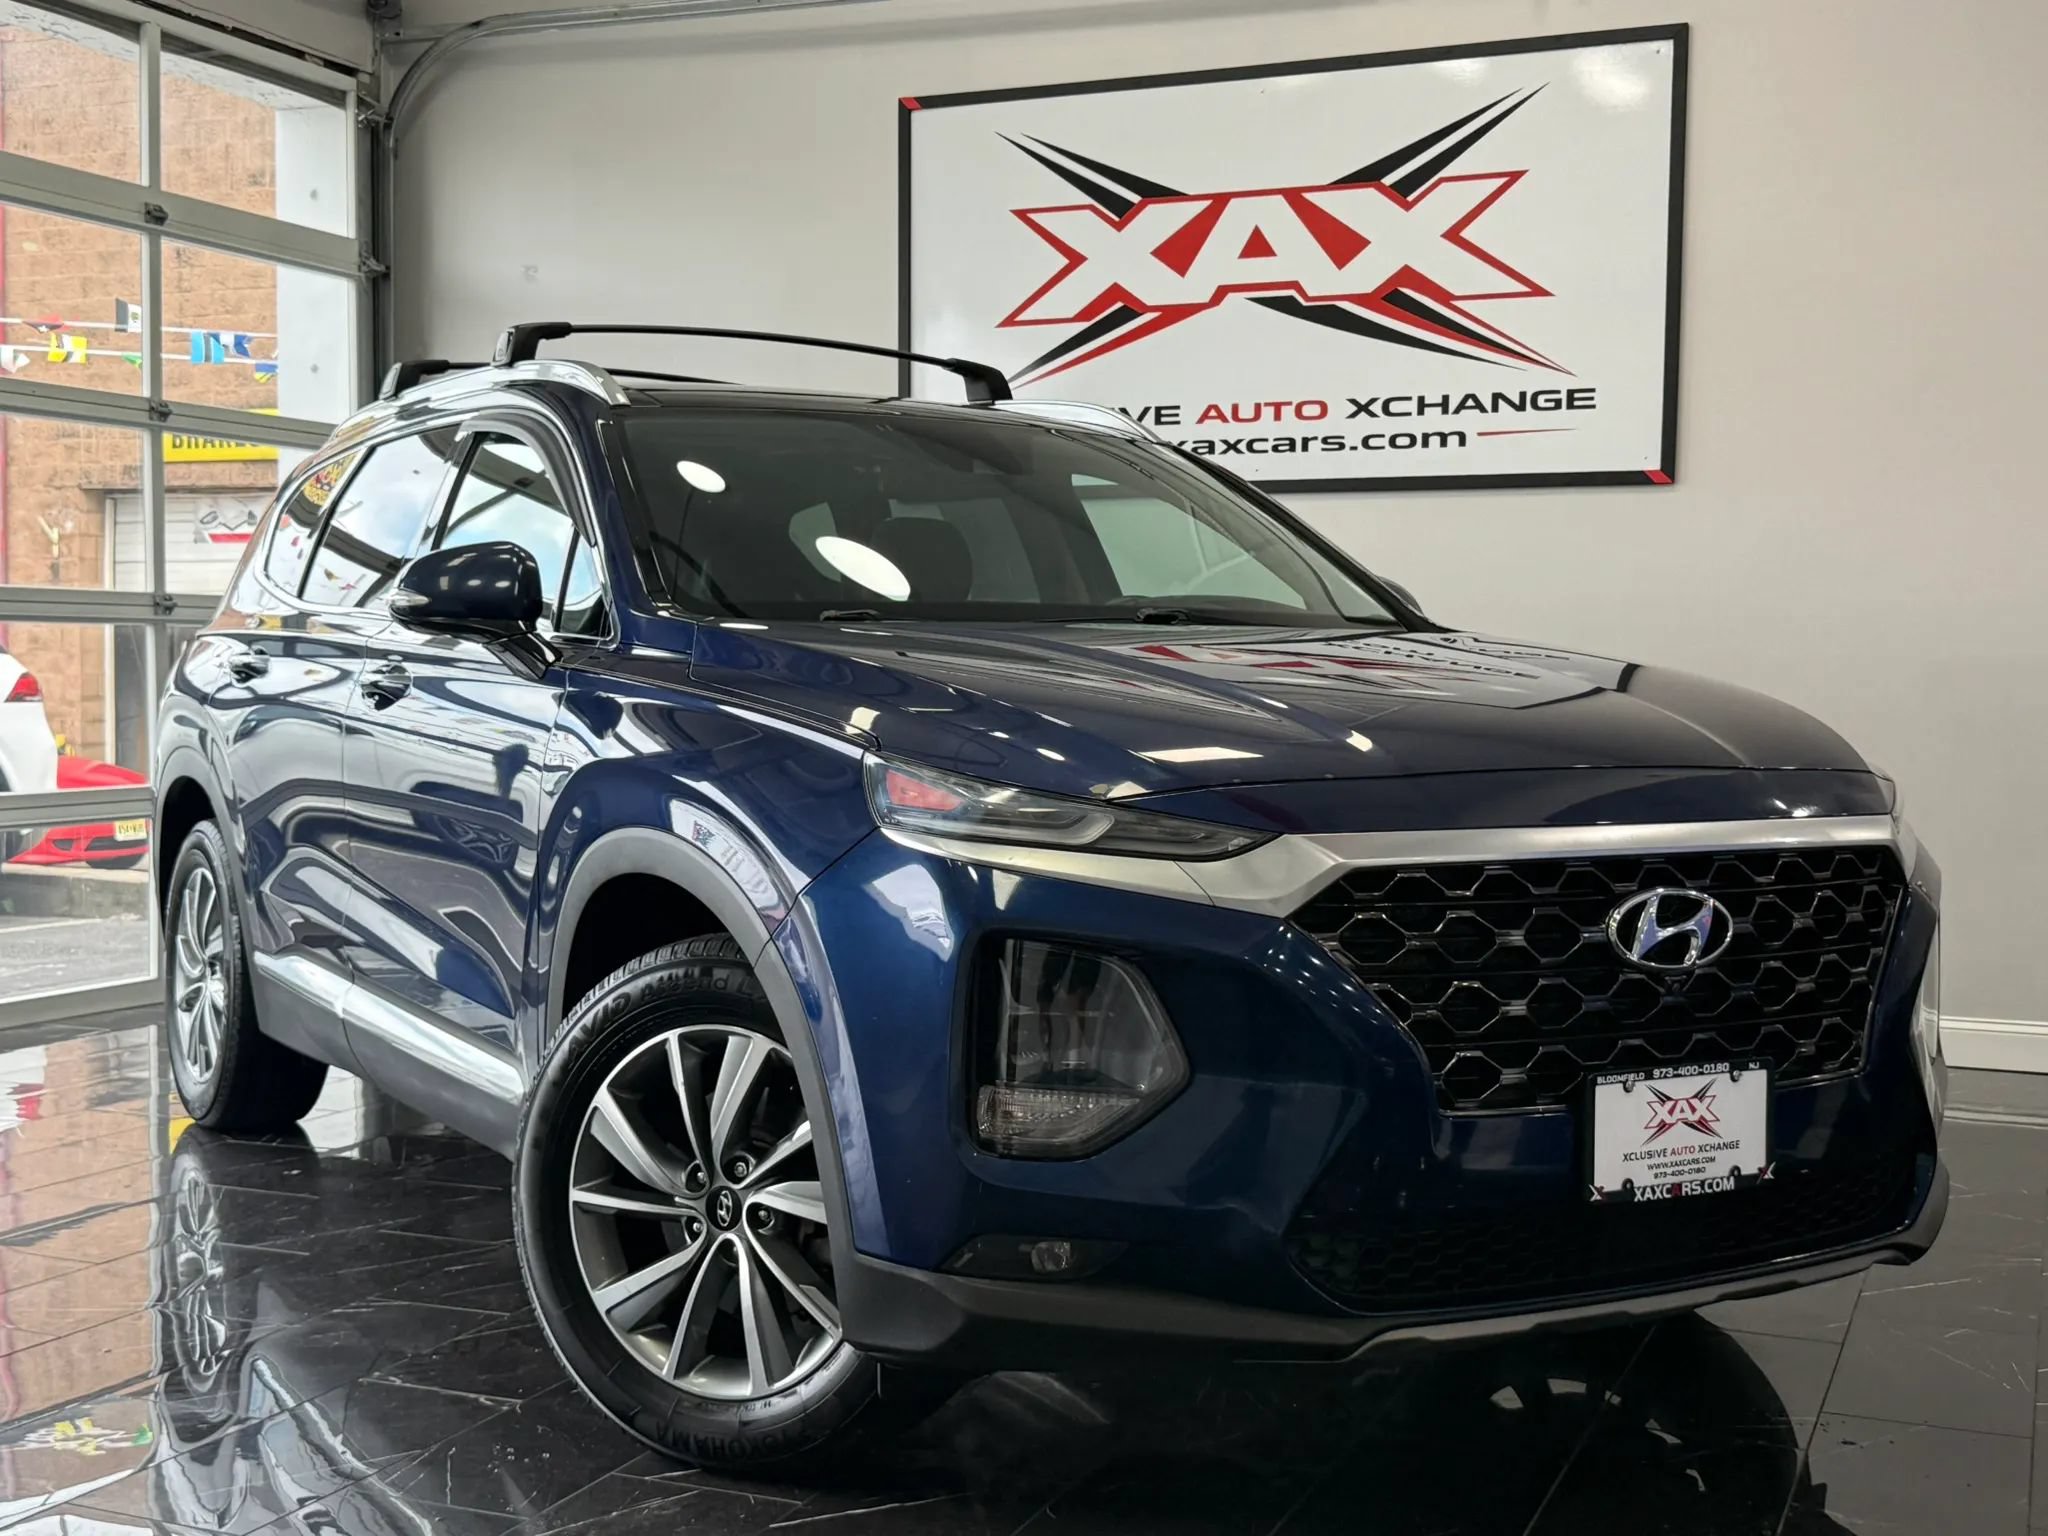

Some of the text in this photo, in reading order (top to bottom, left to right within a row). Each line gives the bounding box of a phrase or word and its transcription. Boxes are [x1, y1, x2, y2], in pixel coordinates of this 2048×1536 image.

[995, 169, 1555, 328] XAX
[1195, 399, 1329, 425] AUTO
[1345, 388, 1597, 419] XCHANGE
[1596, 1062, 1760, 1084] BLOOMFIELD 973-400-0180 NJ
[1643, 1094, 1721, 1129] XAX
[1622, 1140, 1741, 1162] XCLUSIVE AUTO XCHANGE
[1646, 1156, 1716, 1170] WWW.XAXCARS.COM
[1653, 1166, 1706, 1179] 973-400-0180
[1633, 1176, 1735, 1202] XAXCARS.COM
